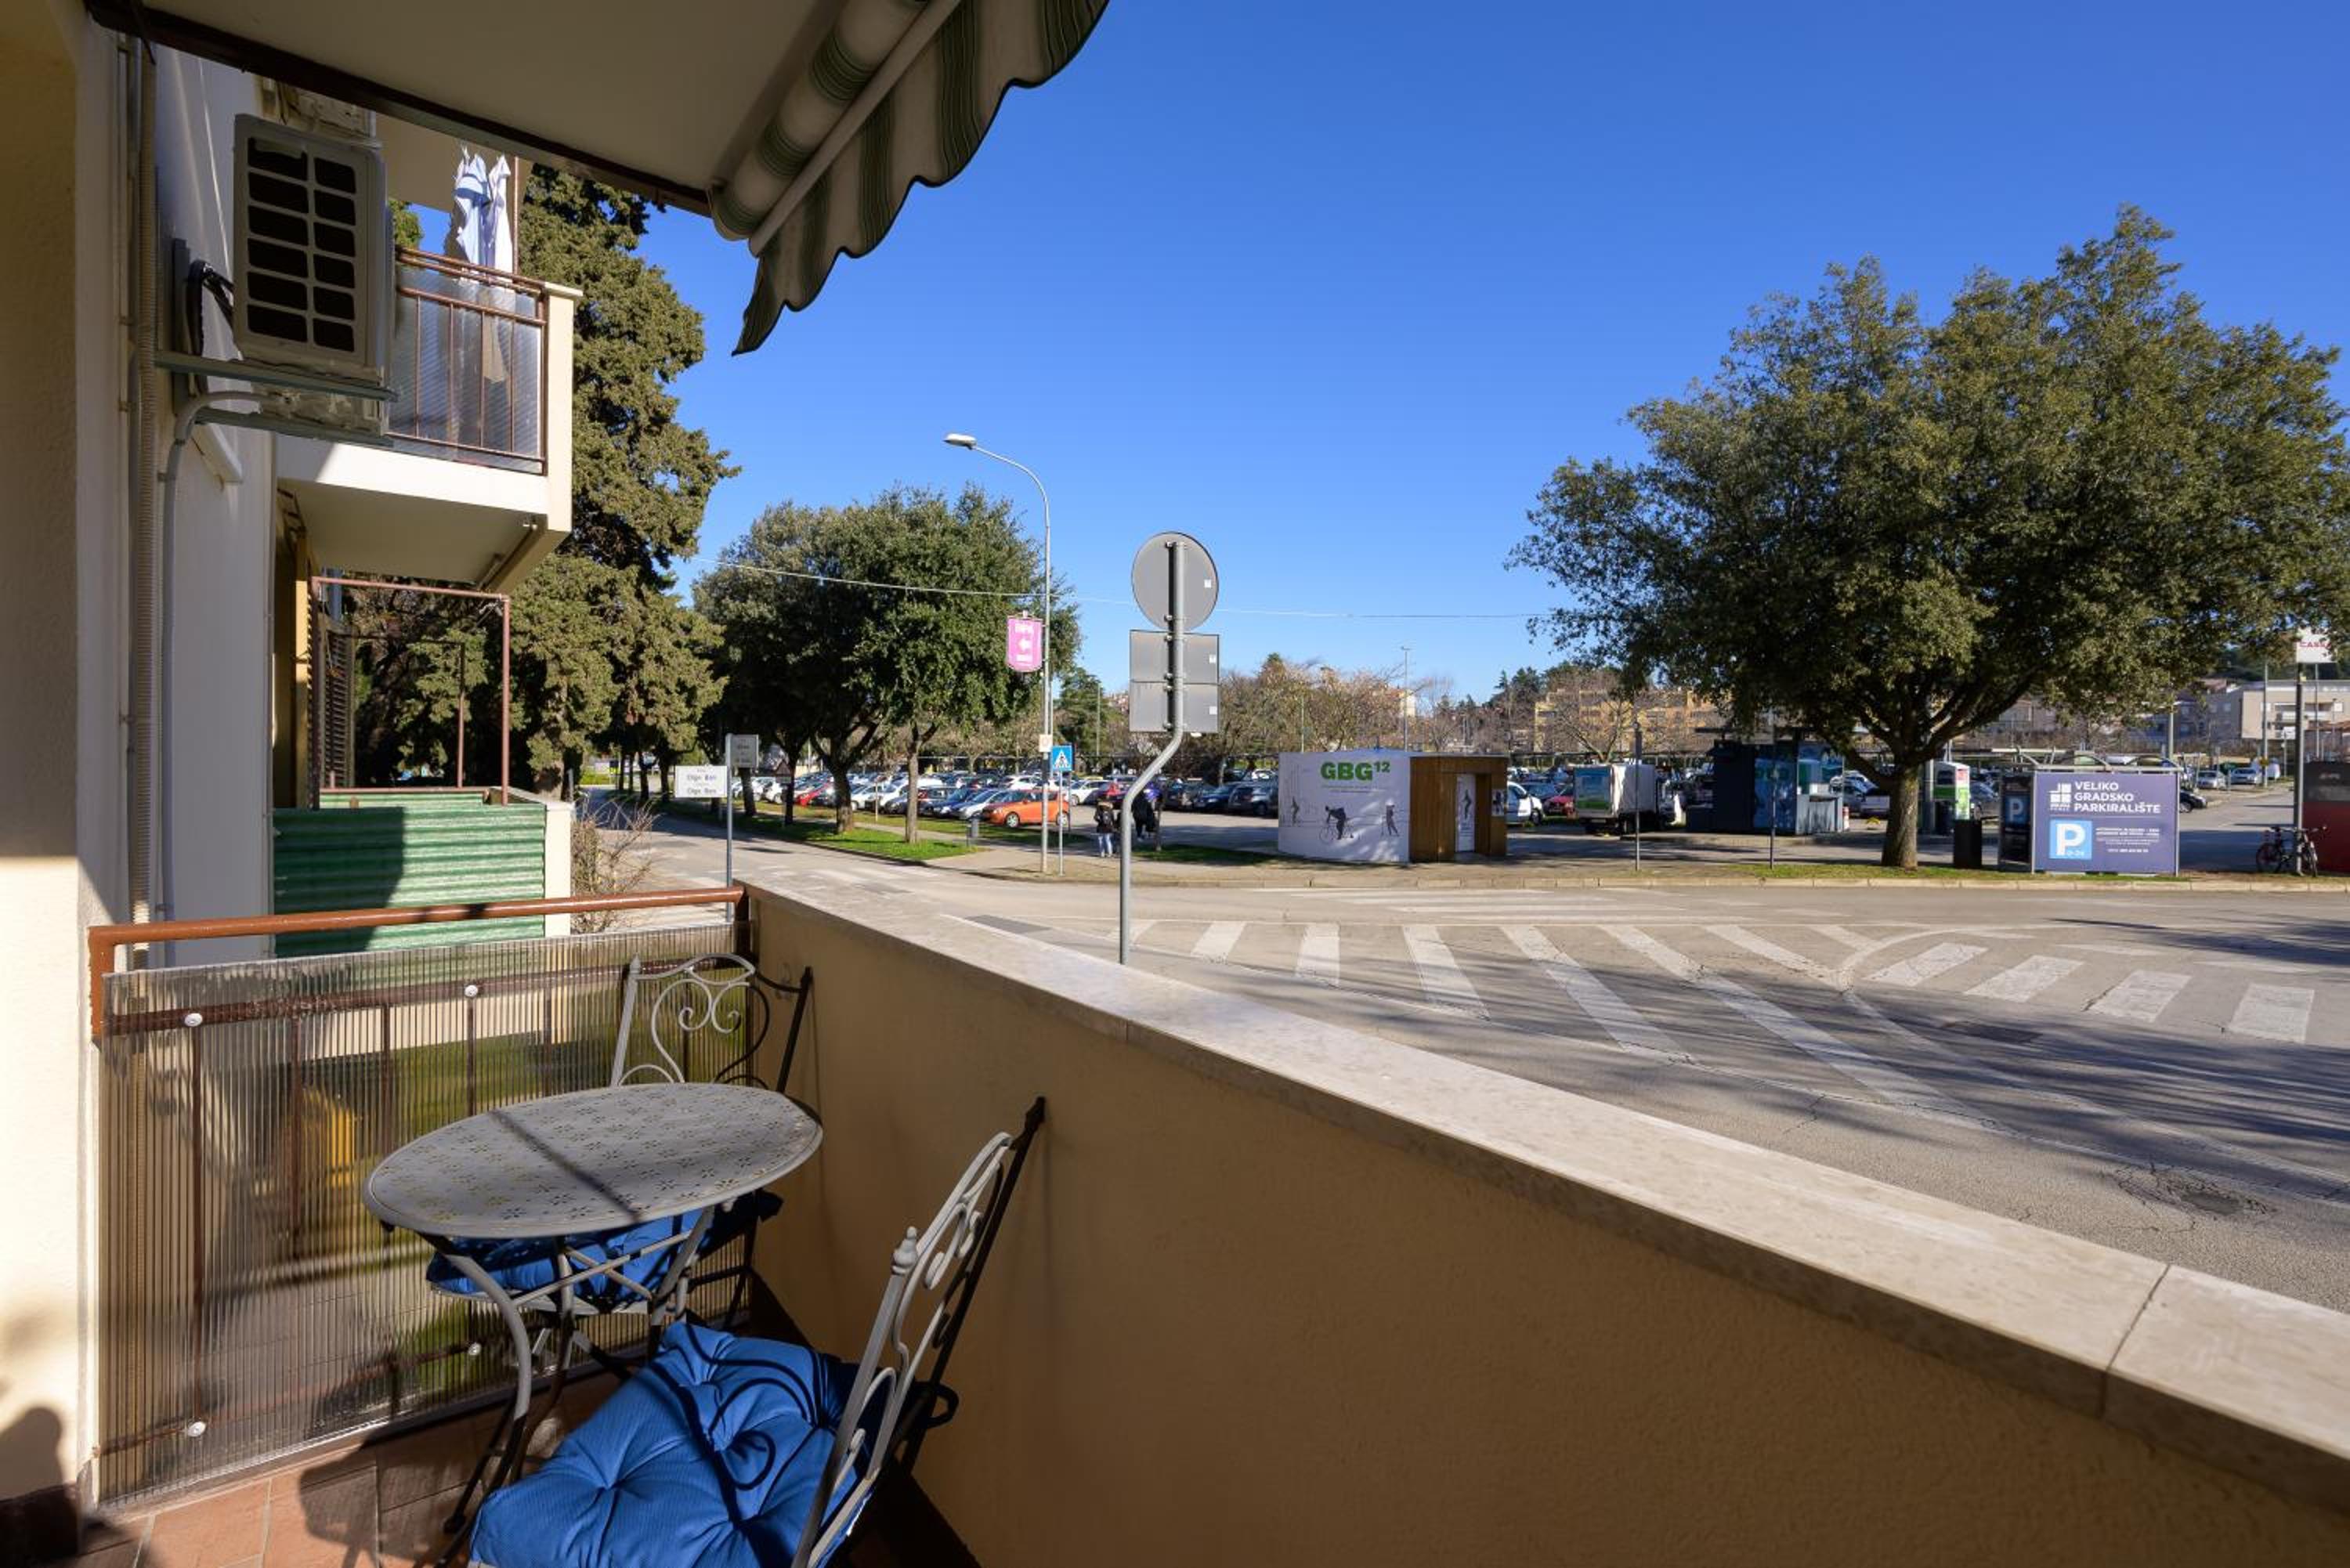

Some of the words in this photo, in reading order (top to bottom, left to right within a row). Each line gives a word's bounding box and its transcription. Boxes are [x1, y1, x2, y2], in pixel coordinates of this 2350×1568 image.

[2074, 781, 2119, 791] VELIKO
[2074, 792, 2134, 802] GRADSKO
[2008, 798, 2023, 822] P
[2074, 802, 2162, 814] PARKIRALIŠTE
[2055, 823, 2085, 857] P
